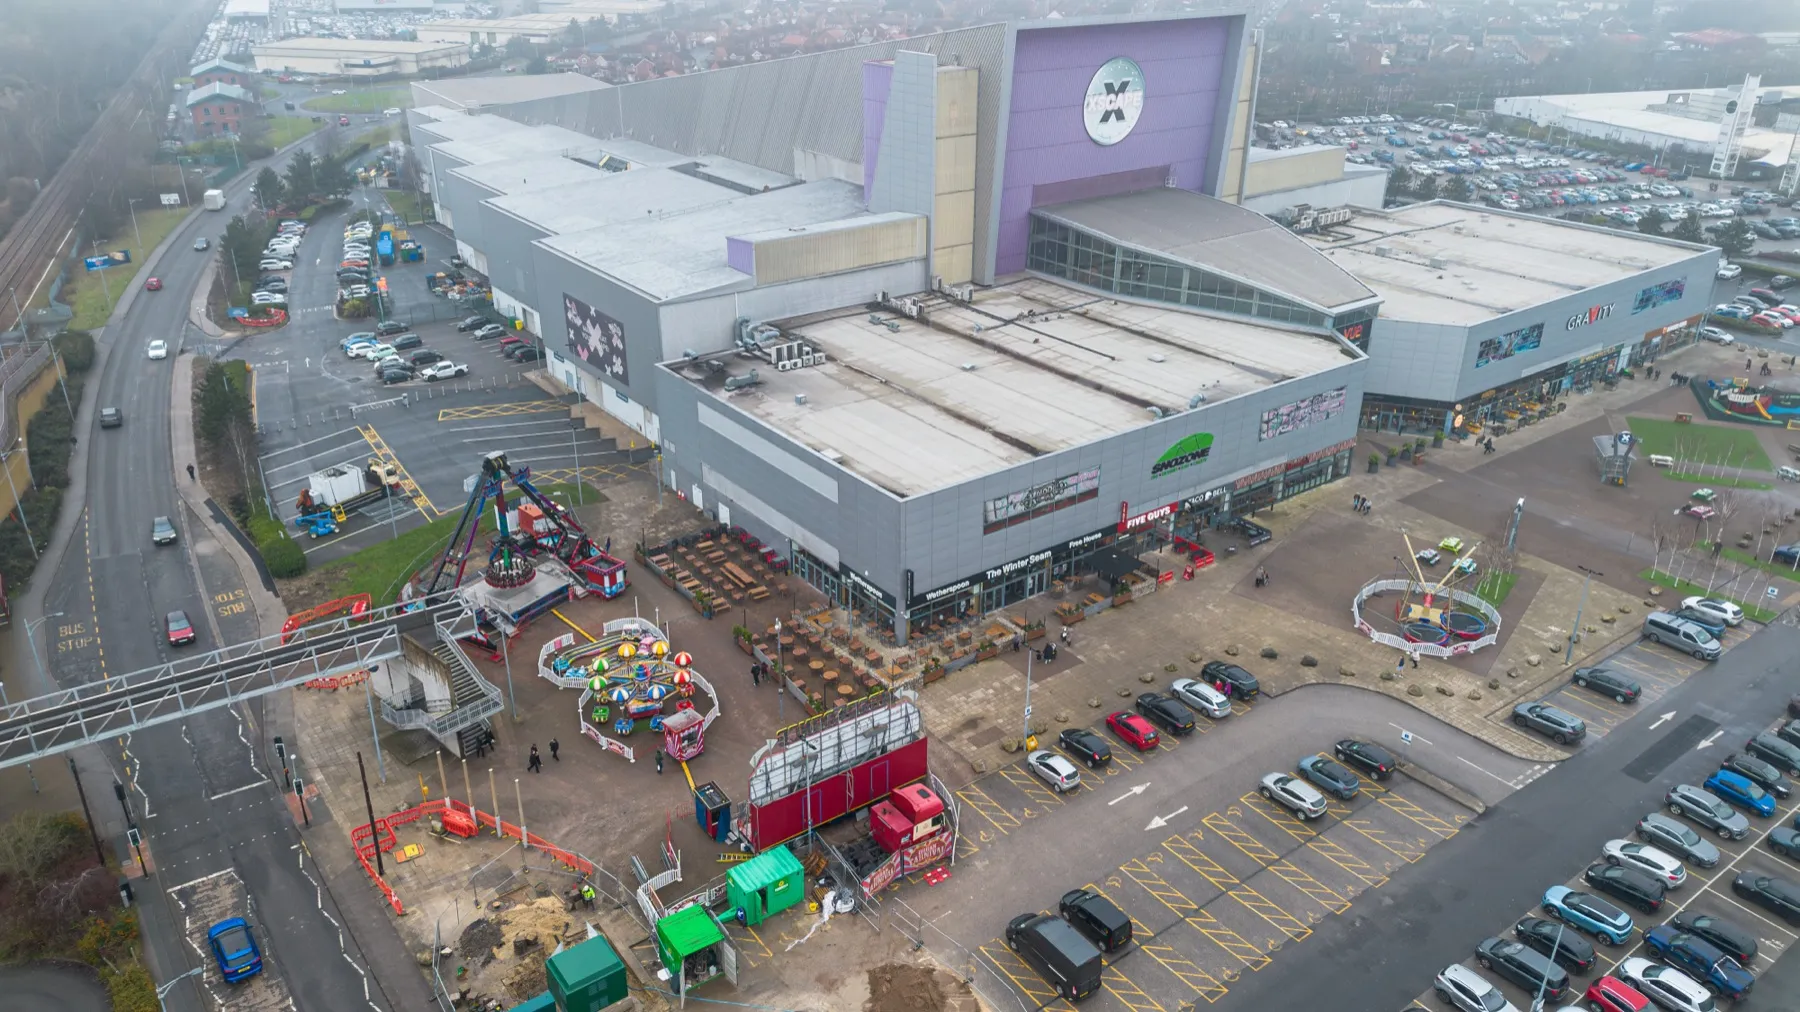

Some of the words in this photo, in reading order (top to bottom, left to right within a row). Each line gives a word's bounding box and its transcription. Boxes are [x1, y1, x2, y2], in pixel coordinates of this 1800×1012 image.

[1567, 303, 1615, 331] GRAVITY
[1151, 447, 1211, 474] SNOZONE
[1213, 486, 1226, 497] BELL
[1127, 514, 1146, 529] FIVE
[1147, 506, 1170, 521] GUYS
[1069, 539, 1083, 549] Free
[1083, 532, 1102, 545] House
[986, 568, 1002, 580] The
[1002, 558, 1029, 575] Winter
[1029, 550, 1052, 564] Seam
[926, 580, 970, 601] Wetherspoon
[218, 602, 246, 617] BUS
[59, 623, 86, 637] BUS
[58, 636, 92, 652] STOP
